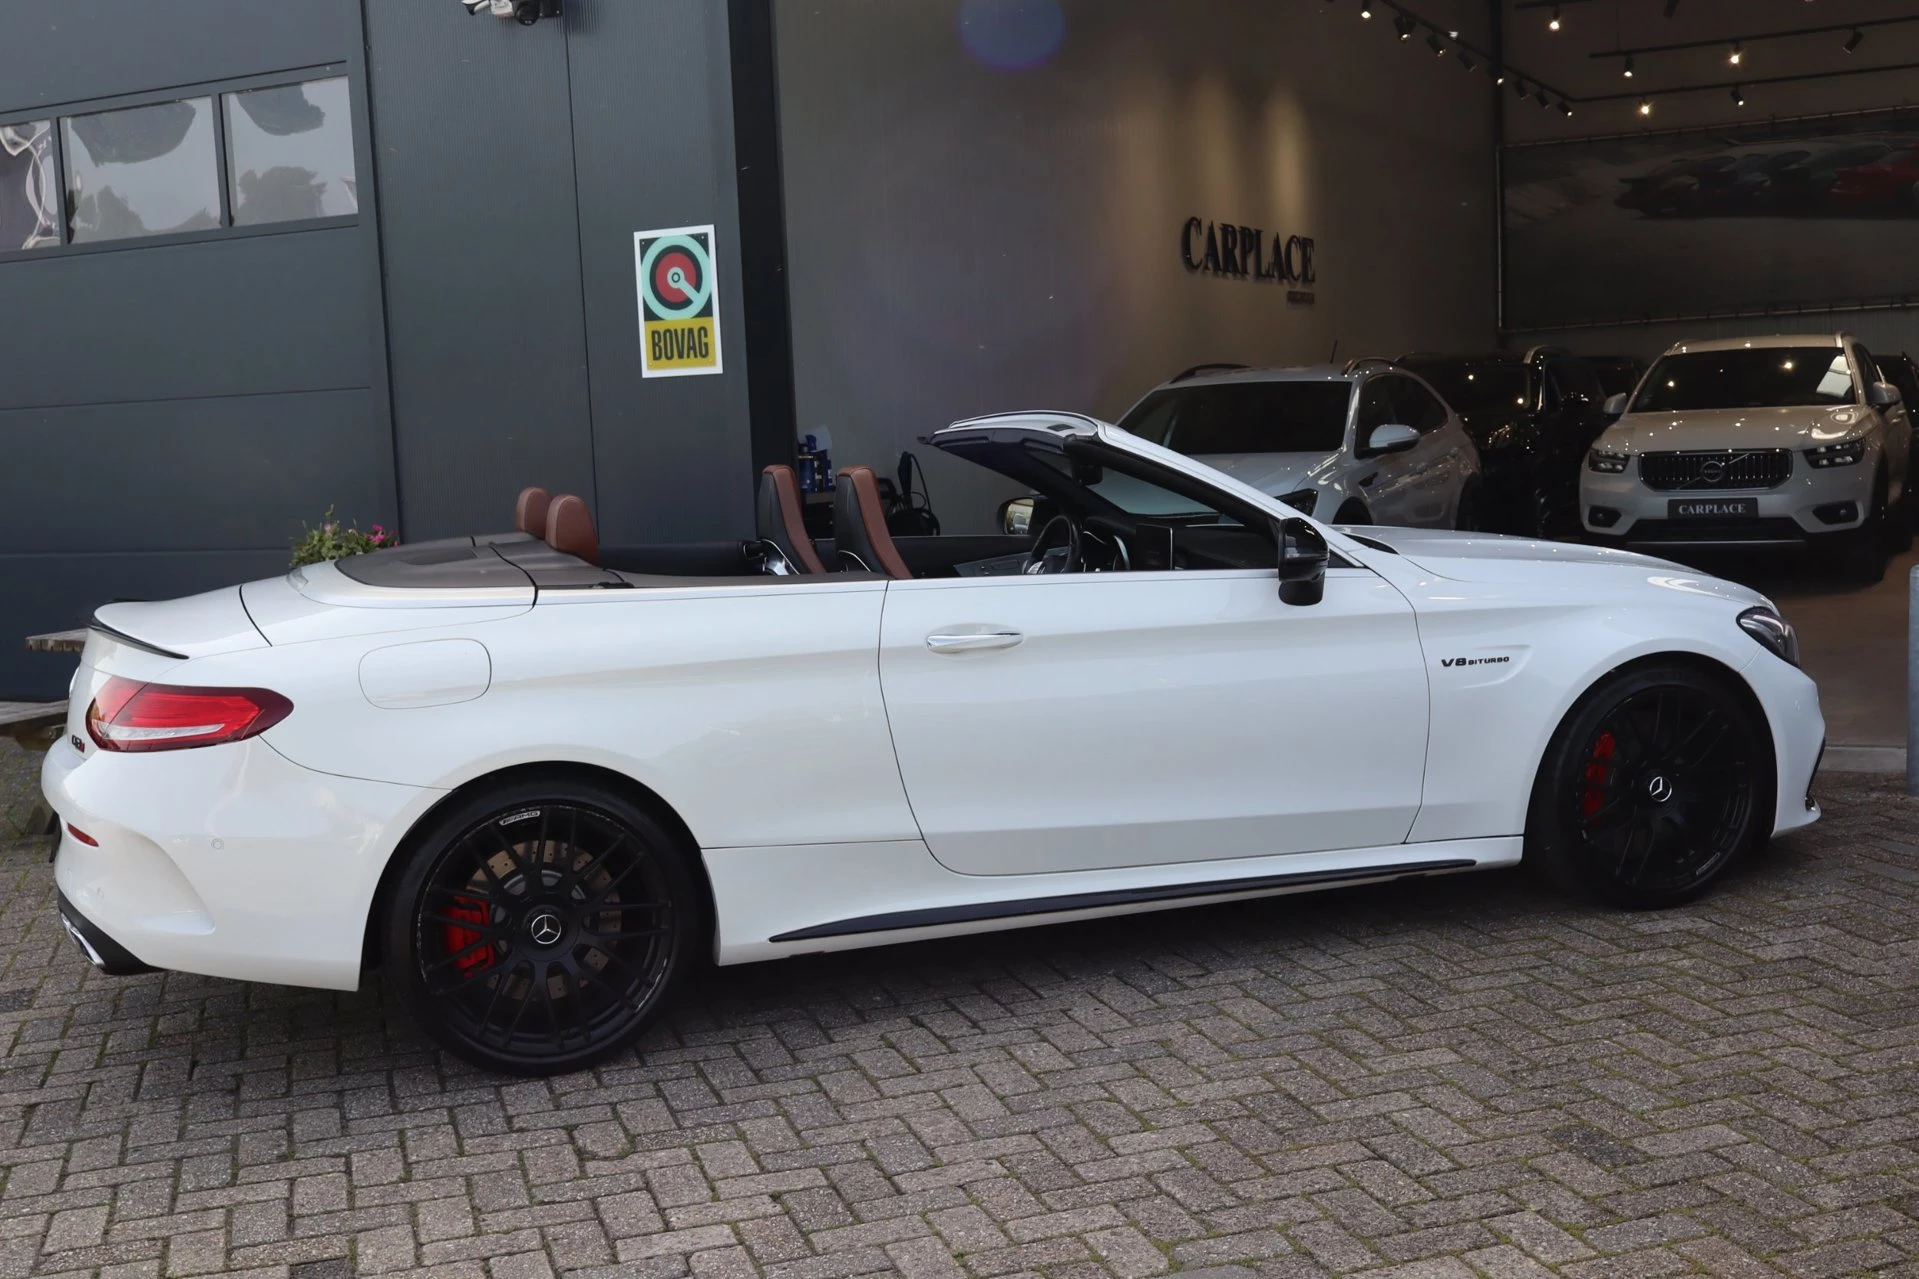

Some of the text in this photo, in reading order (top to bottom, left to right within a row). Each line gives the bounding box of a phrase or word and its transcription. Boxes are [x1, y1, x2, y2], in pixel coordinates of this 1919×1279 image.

[1181, 216, 1315, 283] CARPLACE
[651, 326, 709, 361] BOVAG
[1678, 503, 1746, 515] CARPLACE
[1441, 656, 1510, 667] V8 BITURBO
